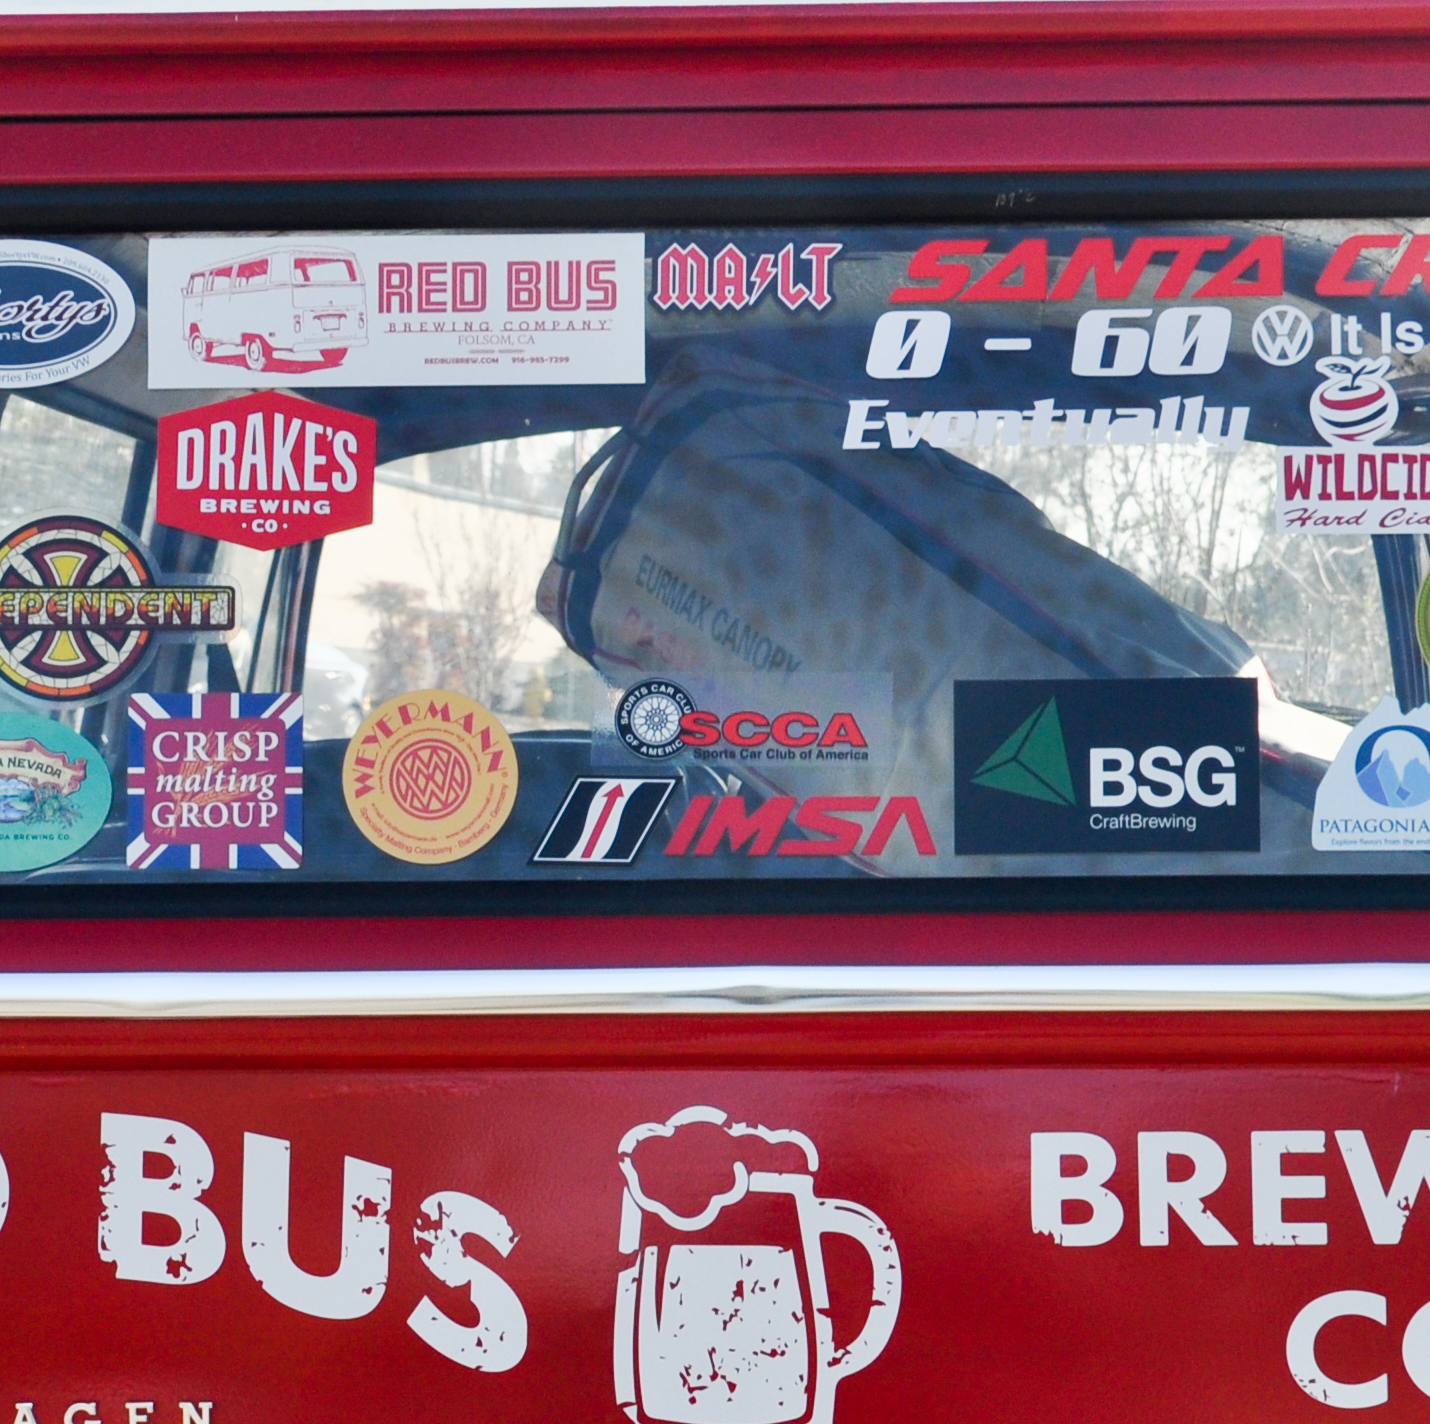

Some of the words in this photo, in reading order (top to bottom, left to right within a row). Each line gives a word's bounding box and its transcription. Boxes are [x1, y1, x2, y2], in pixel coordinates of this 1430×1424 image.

[888, 235, 1284, 301] SANTA
[378, 261, 487, 313] RED
[507, 260, 617, 312] BUS
[388, 321, 491, 332] BREWING
[503, 320, 609, 331] COMPANY
[458, 334, 515, 346] FOLSOM,
[517, 334, 535, 345] CA
[1071, 306, 1232, 377] 60
[1330, 311, 1363, 356] It
[1380, 311, 1425, 356] Is
[25, 370, 43, 382] For
[46, 364, 70, 379] Your
[71, 355, 90, 370] VW
[842, 395, 1251, 452] Eventually
[176, 411, 359, 494] DRAKE'S
[199, 498, 331, 515] BREWING
[1283, 507, 1368, 528] Hard
[621, 686, 649, 725] SPORTS
[651, 683, 675, 696] CAR
[675, 692, 692, 715] CLU
[625, 733, 640, 747] OF
[640, 739, 684, 757] AMERIC
[678, 710, 869, 748] SCCA
[151, 731, 280, 763] CRISP
[352, 699, 508, 800] WEYERMANN
[693, 749, 736, 761] Sports
[740, 749, 763, 760] Car
[766, 748, 797, 760] Club
[799, 748, 813, 760] of
[816, 748, 869, 760] America
[7, 756, 63, 778] NEVADA
[155, 765, 277, 801] malting
[1089, 745, 1237, 808] BSG
[151, 802, 279, 828] GROUP
[414, 845, 453, 855] Company
[458, 822, 491, 848] Bamberg
[490, 783, 509, 818] Germany
[664, 795, 937, 857] IMSA
[1089, 814, 1197, 832] CraftBrewing
[1320, 818, 1430, 833] PATAGONIA
[13, 833, 55, 841] BREWING
[1331, 838, 1358, 846] Explore
[1359, 837, 1383, 845] flavors
[1383, 837, 1401, 845] from
[1402, 837, 1414, 845] the
[97, 1111, 530, 1373] BUS
